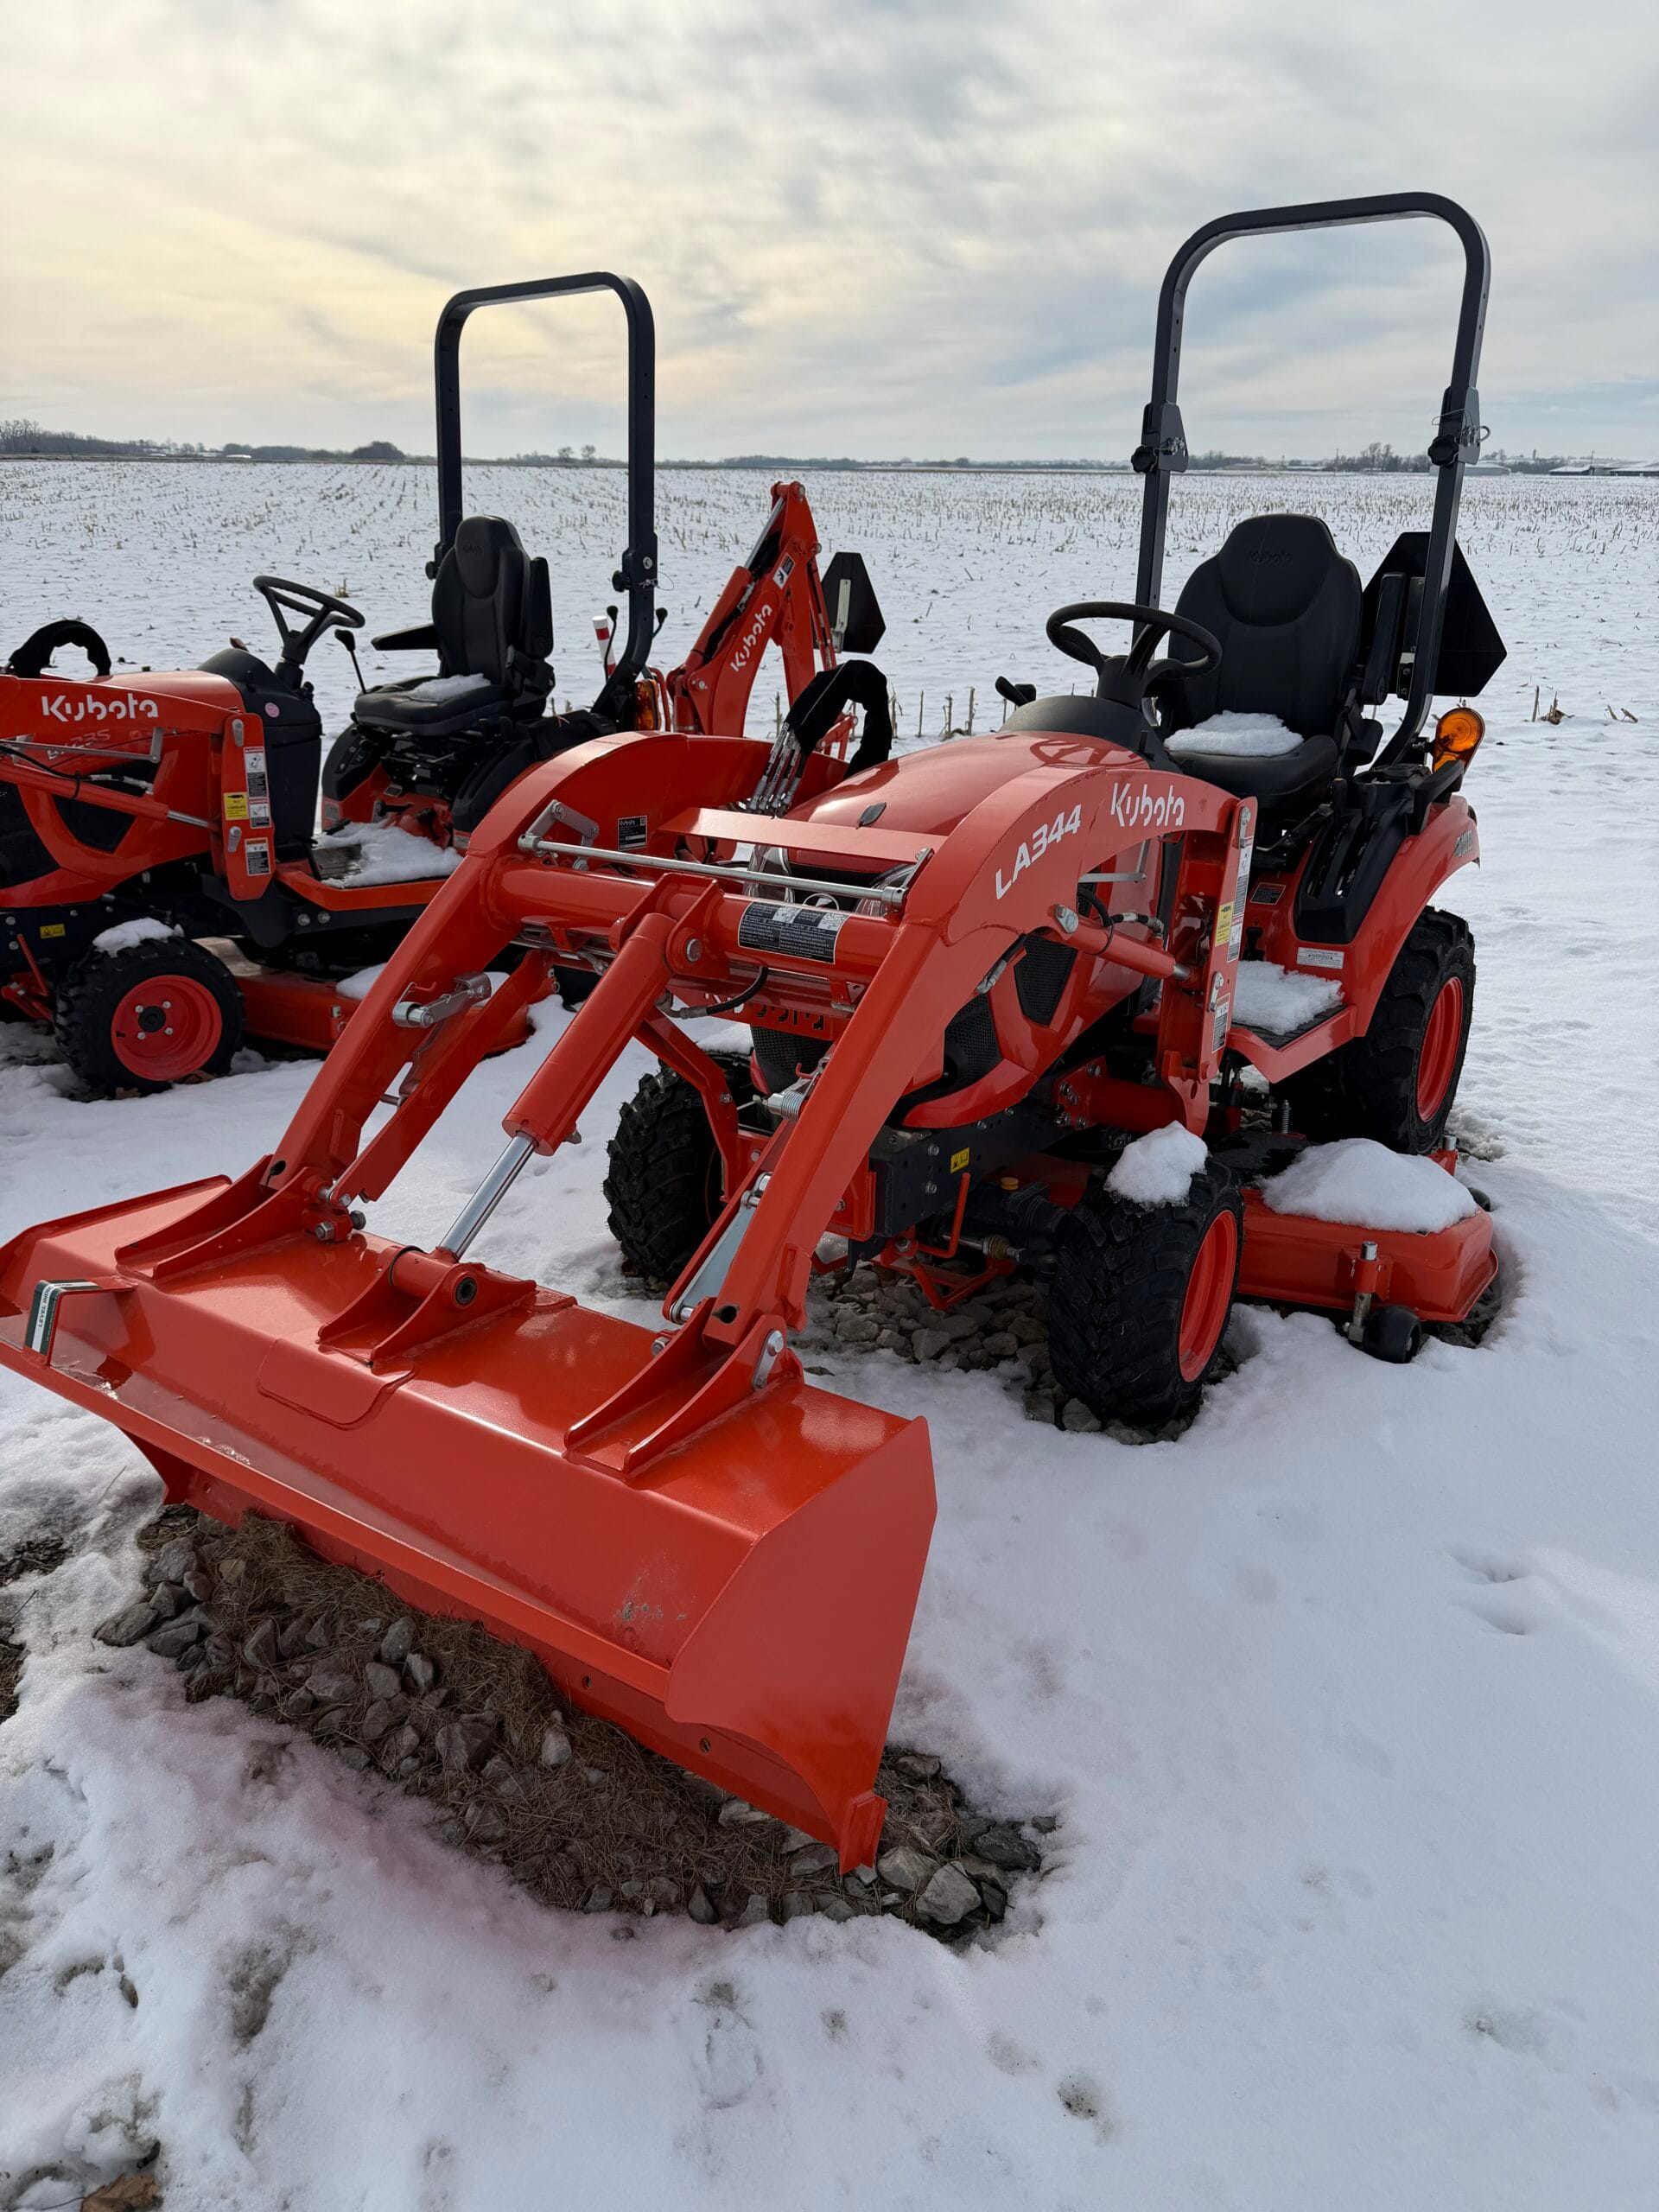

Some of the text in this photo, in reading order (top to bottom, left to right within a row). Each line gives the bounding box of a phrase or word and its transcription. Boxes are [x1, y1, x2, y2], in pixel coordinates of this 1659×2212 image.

[729, 605, 772, 672] Kubota
[41, 693, 159, 722] Kubota
[1110, 782, 1185, 827] Kubota
[995, 804, 1082, 899] LA344
[38, 1304, 47, 1328] LEVEL
